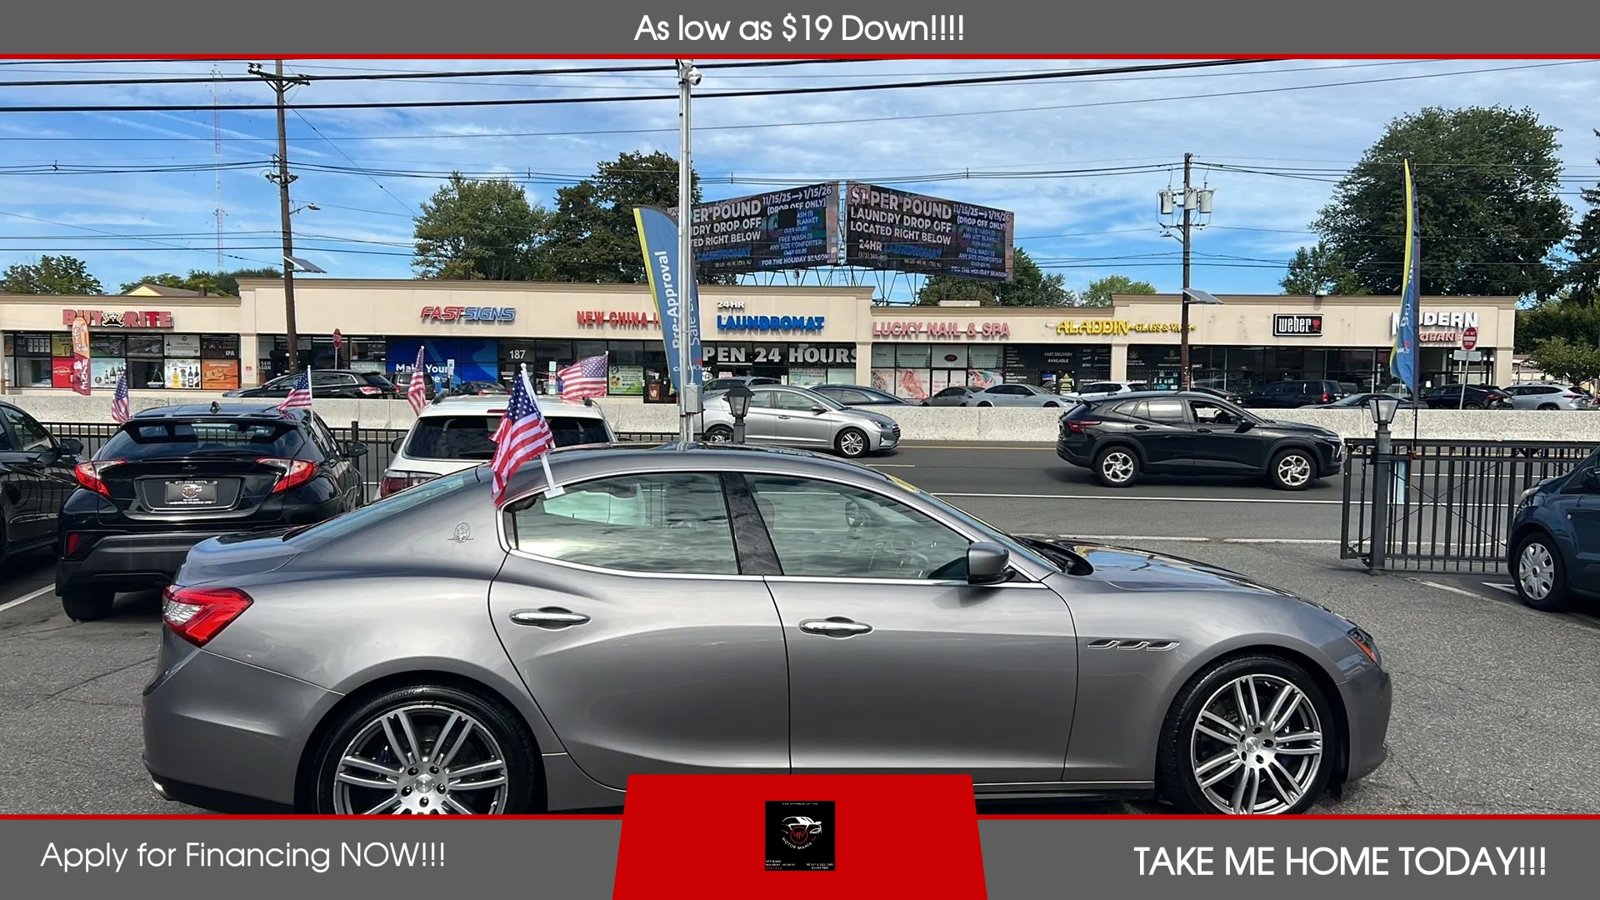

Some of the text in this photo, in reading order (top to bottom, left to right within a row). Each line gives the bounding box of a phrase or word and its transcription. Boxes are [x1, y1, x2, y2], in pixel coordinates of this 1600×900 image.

[763, 185, 832, 206] 11/15/25 1/15/26
[690, 199, 762, 223] ER POUND
[870, 190, 898, 211] PER
[902, 197, 952, 219] POUND
[714, 220, 740, 236] DROP
[742, 216, 762, 230] OFF
[850, 206, 901, 225] LAUNDRY
[903, 217, 932, 231] DROP
[933, 221, 952, 233] OFF
[705, 233, 729, 247] RIGHT
[730, 230, 762, 243] BELOW
[850, 221, 893, 237] LOCATED
[894, 227, 920, 241] RIGHT
[921, 231, 952, 246] BELOW
[858, 239, 883, 252] 24HR
[717, 300, 745, 309] 24HR
[121, 311, 173, 331] RITE
[420, 306, 516, 322] FASTSIGNS
[576, 311, 605, 327] NEW
[608, 312, 648, 328] CHINA
[716, 315, 825, 331] LAUNDROMAT
[872, 321, 1011, 337] LUCKY NAIL & SPA
[1056, 319, 1130, 336] ALADDIN
[1135, 322, 1161, 333] GLASS
[1277, 316, 1313, 334] weber
[509, 350, 526, 360] 187
[702, 346, 746, 363] PEN
[754, 347, 782, 363] 24
[395, 363, 418, 374] Mak
